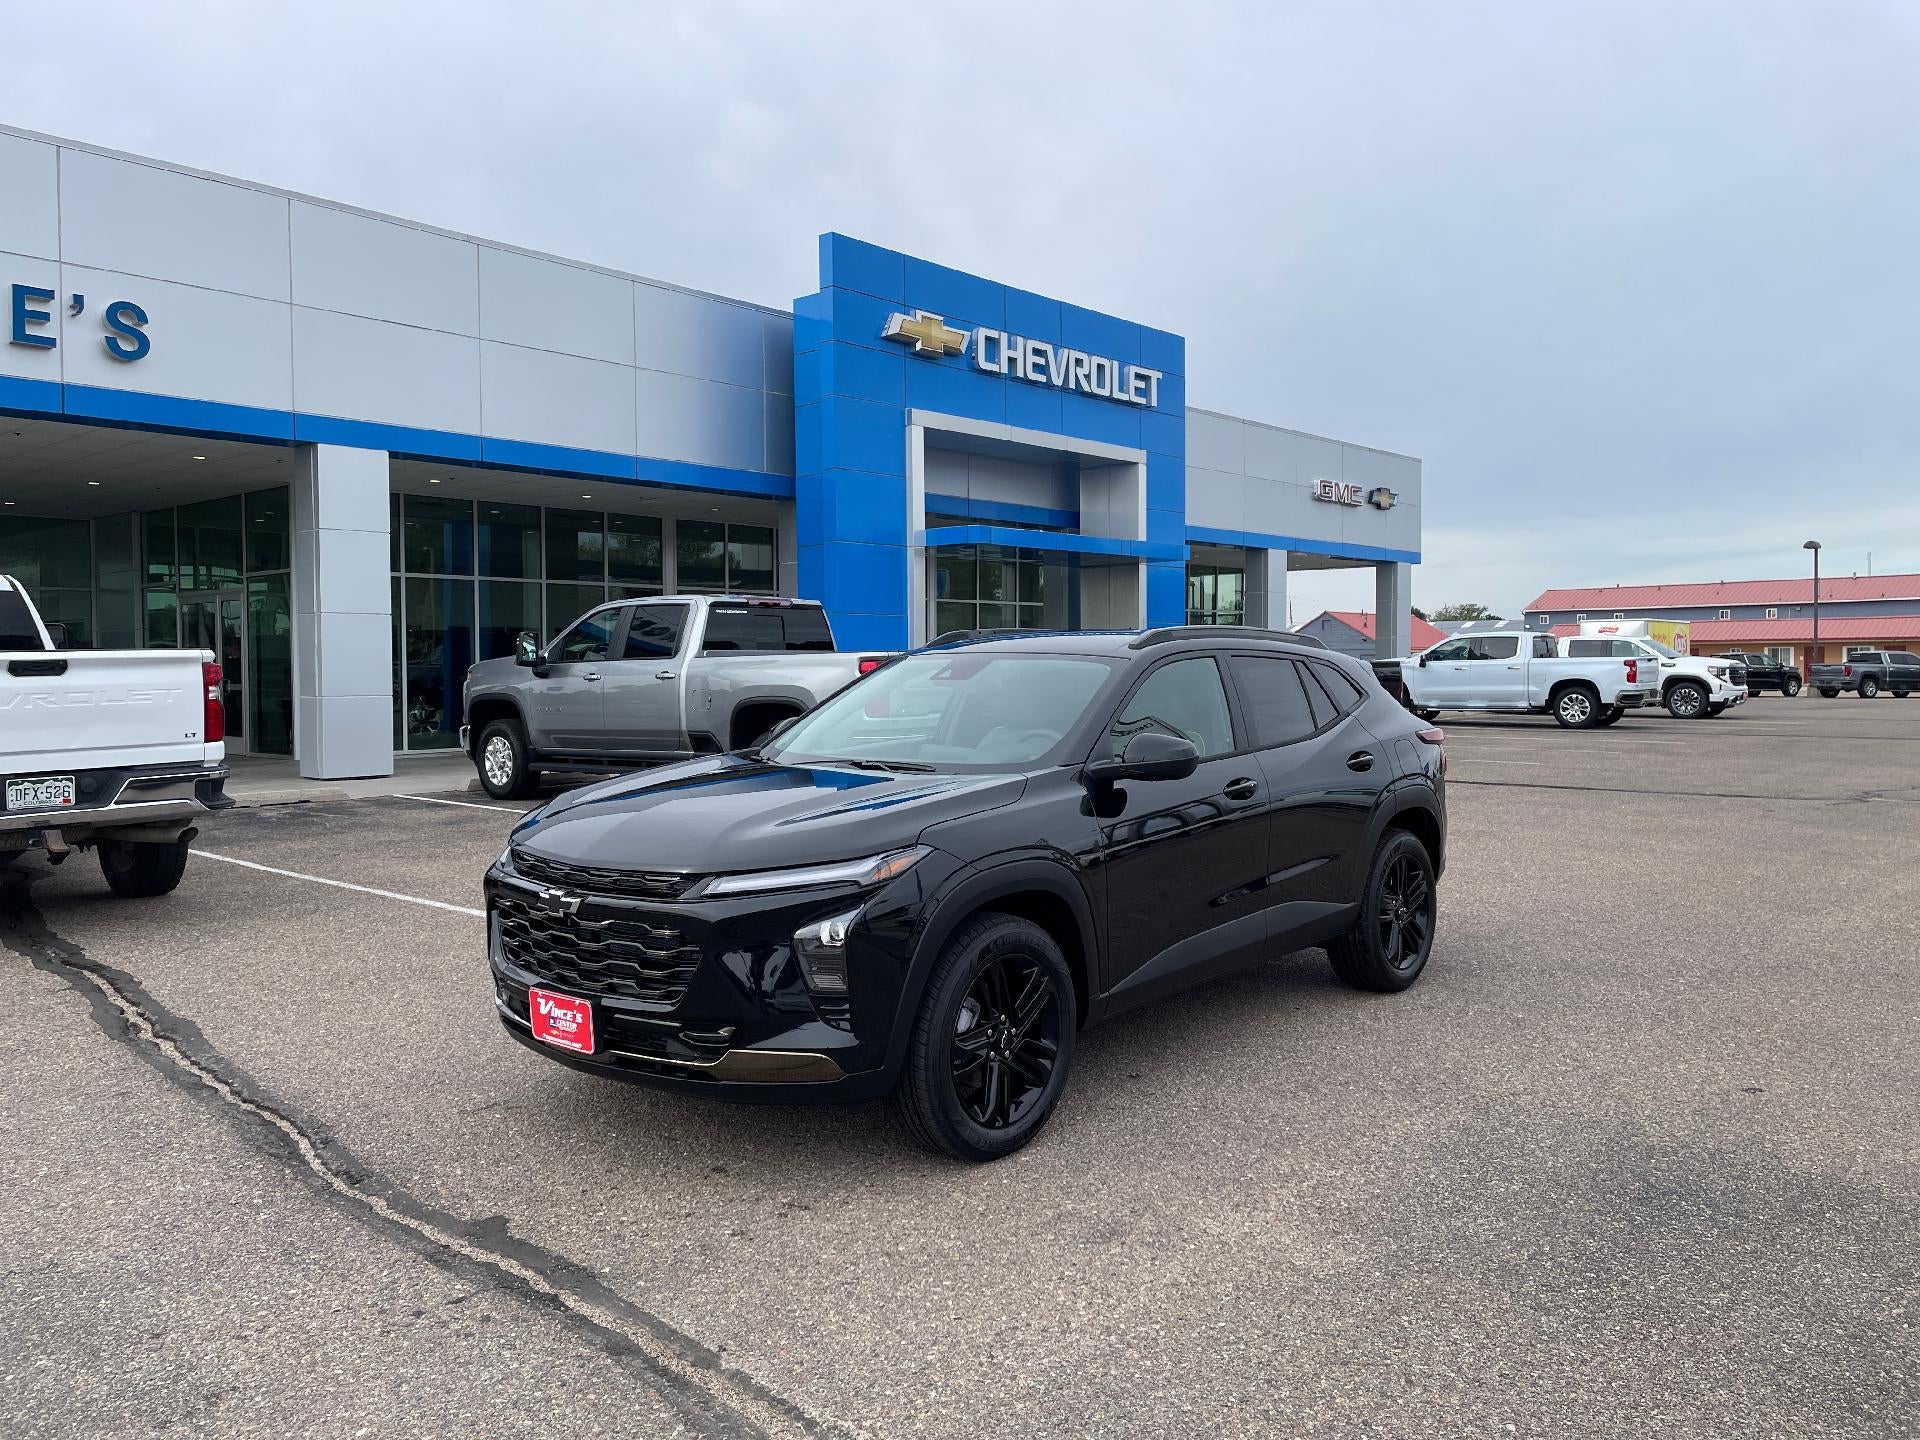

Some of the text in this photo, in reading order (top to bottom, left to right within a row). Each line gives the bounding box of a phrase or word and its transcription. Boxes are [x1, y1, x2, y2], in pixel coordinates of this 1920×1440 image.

[10, 283, 151, 361] E'S
[971, 327, 1163, 407] CHEVROLET
[1314, 479, 1364, 506] GMC
